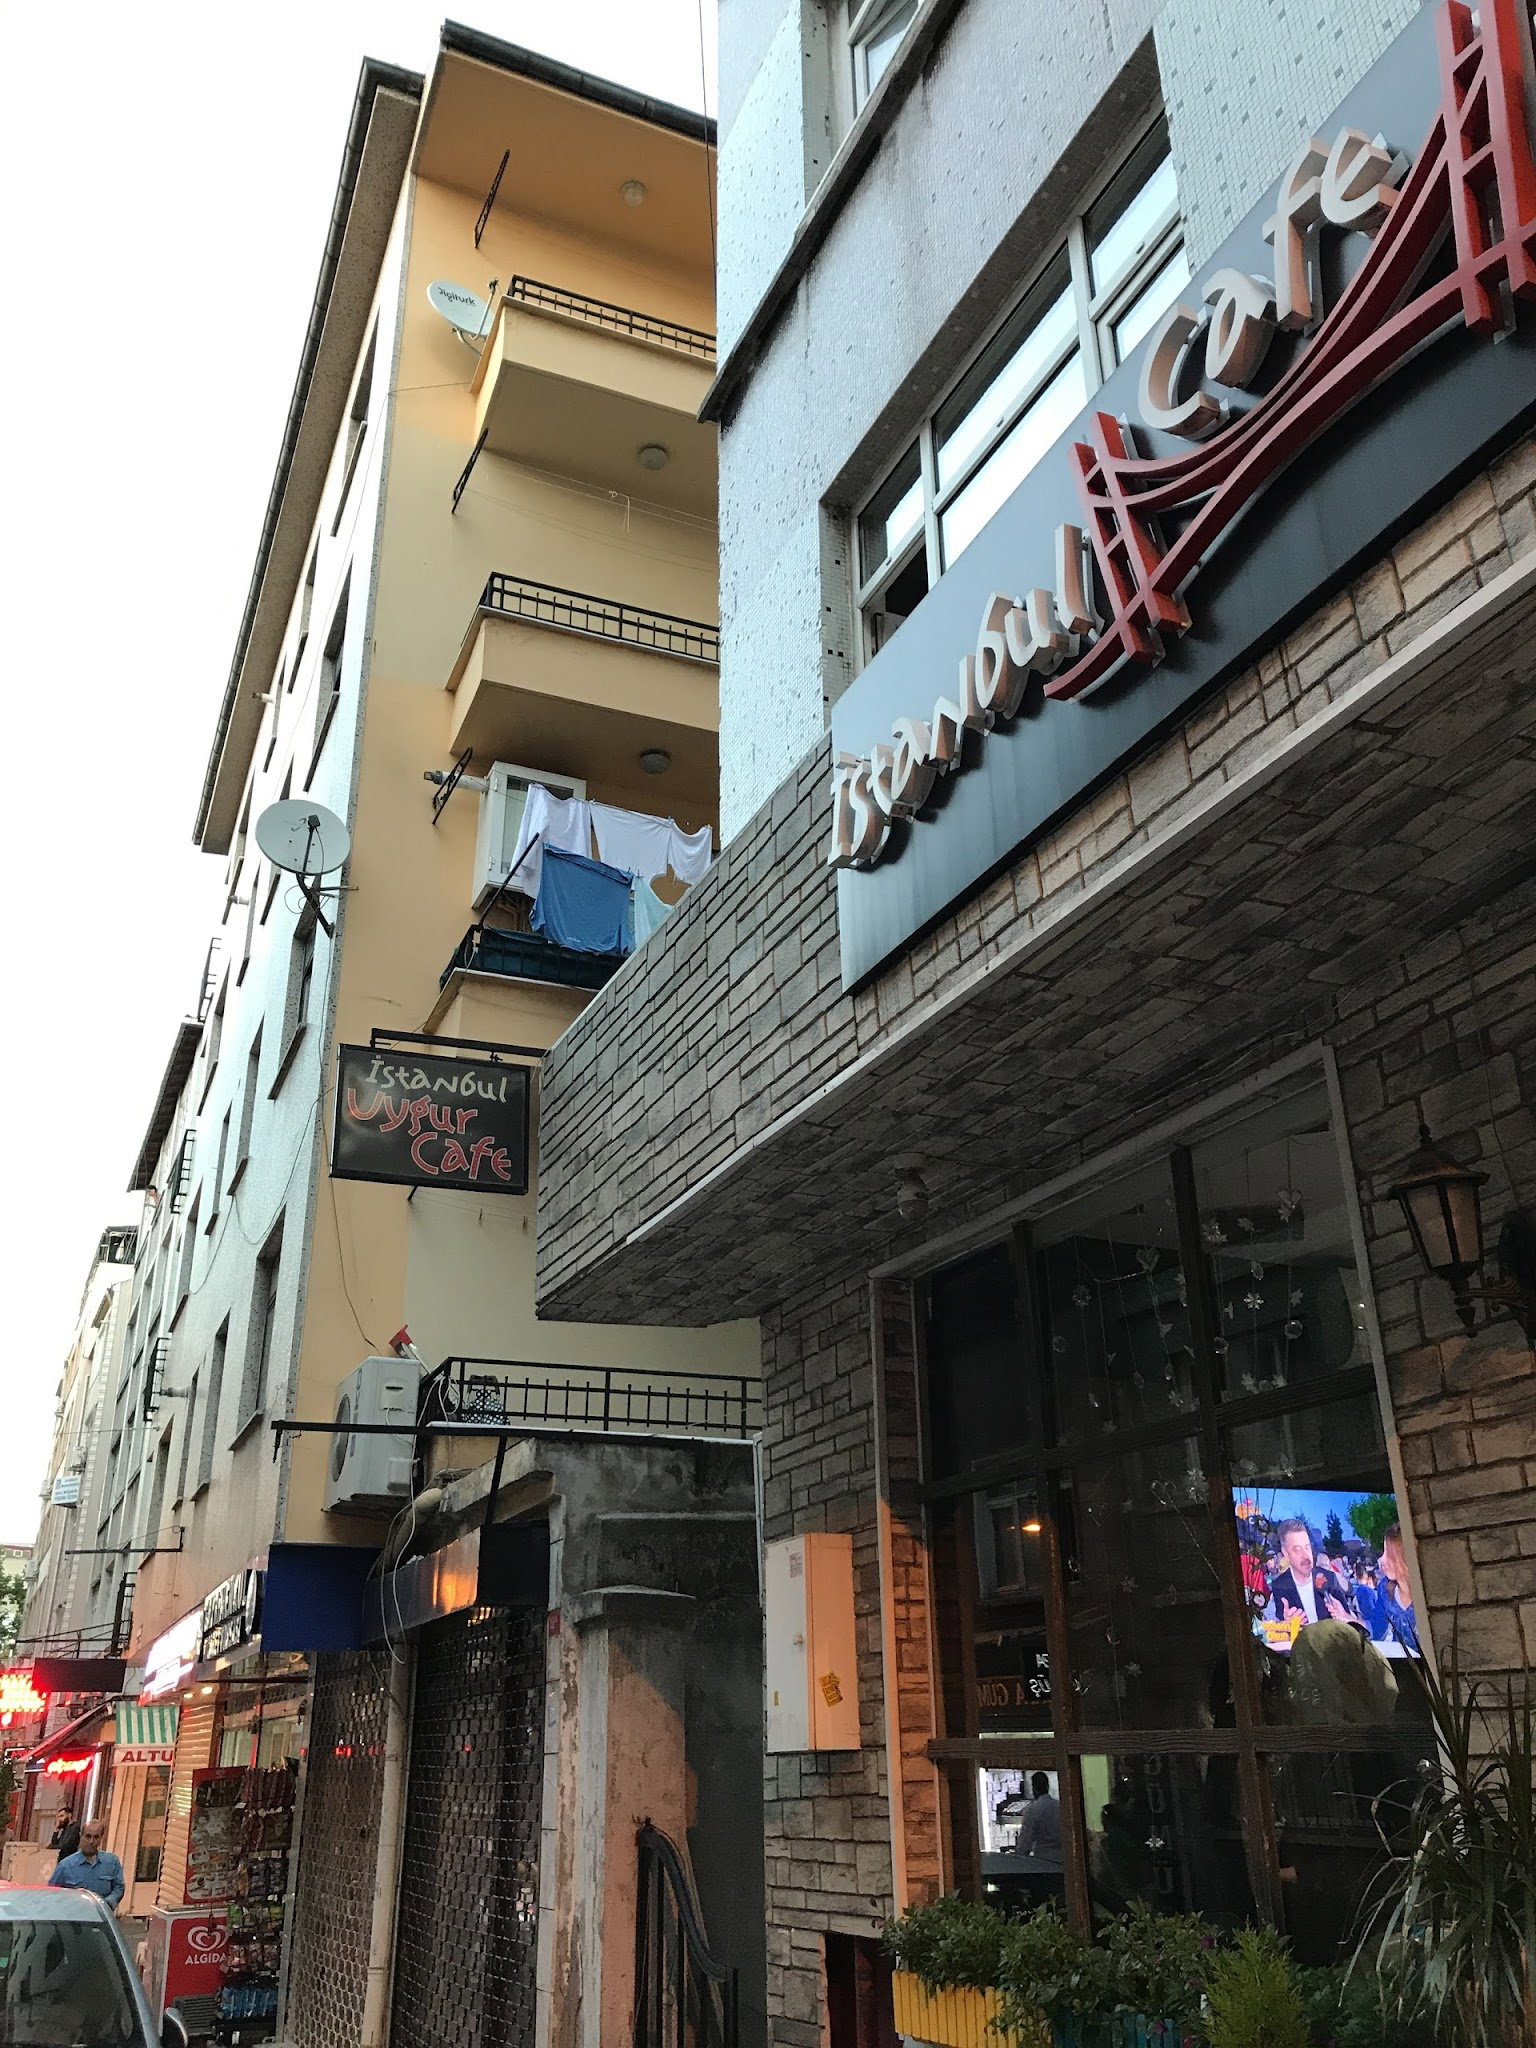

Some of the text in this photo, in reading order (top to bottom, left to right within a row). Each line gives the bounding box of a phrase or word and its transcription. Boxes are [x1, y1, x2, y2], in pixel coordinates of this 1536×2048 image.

[1137, 126, 1408, 440] Cafe
[347, 1087, 478, 1136] Uygur
[410, 1131, 512, 1181] Cafe
